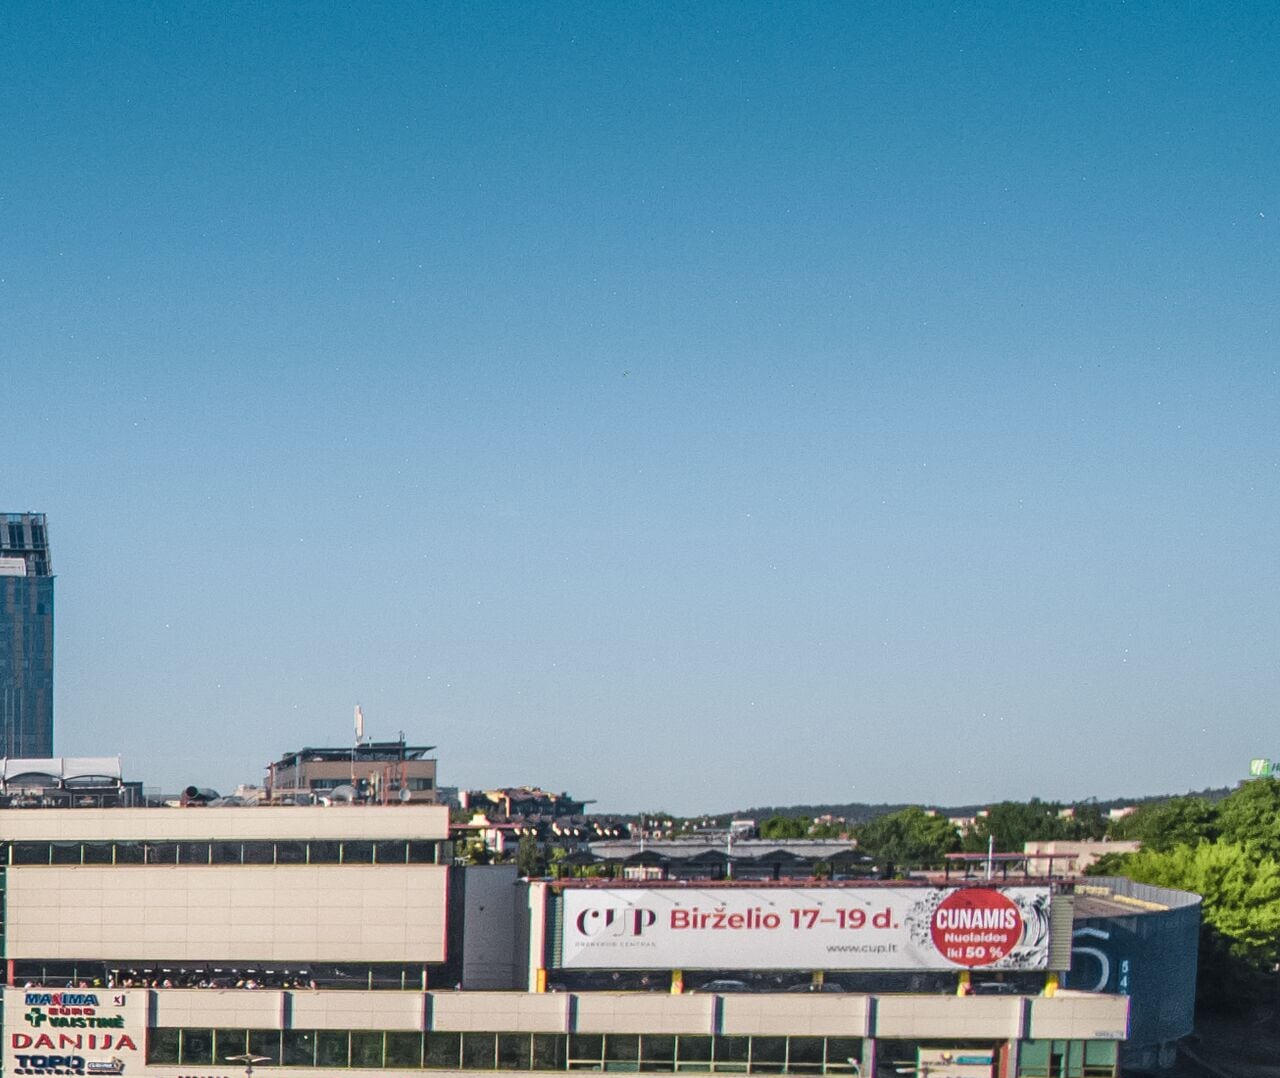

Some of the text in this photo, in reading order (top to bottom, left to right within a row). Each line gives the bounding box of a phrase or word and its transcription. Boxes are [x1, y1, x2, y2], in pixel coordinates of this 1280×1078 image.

[576, 908, 657, 937] CUP
[670, 906, 781, 930] Birželio
[872, 907, 899, 930] d.
[936, 908, 1017, 931] CUNAMIS
[944, 932, 1008, 944] Nuolaidos
[826, 943, 898, 955] www.cup.lt
[965, 947, 986, 959] 50
[988, 947, 1004, 959] %
[25, 992, 100, 1007] MAXIMA
[48, 1007, 95, 1016] EURO
[48, 1014, 125, 1029] VAISTINĖ
[12, 1033, 137, 1051] DANIJA
[14, 1055, 86, 1069] TOPO
